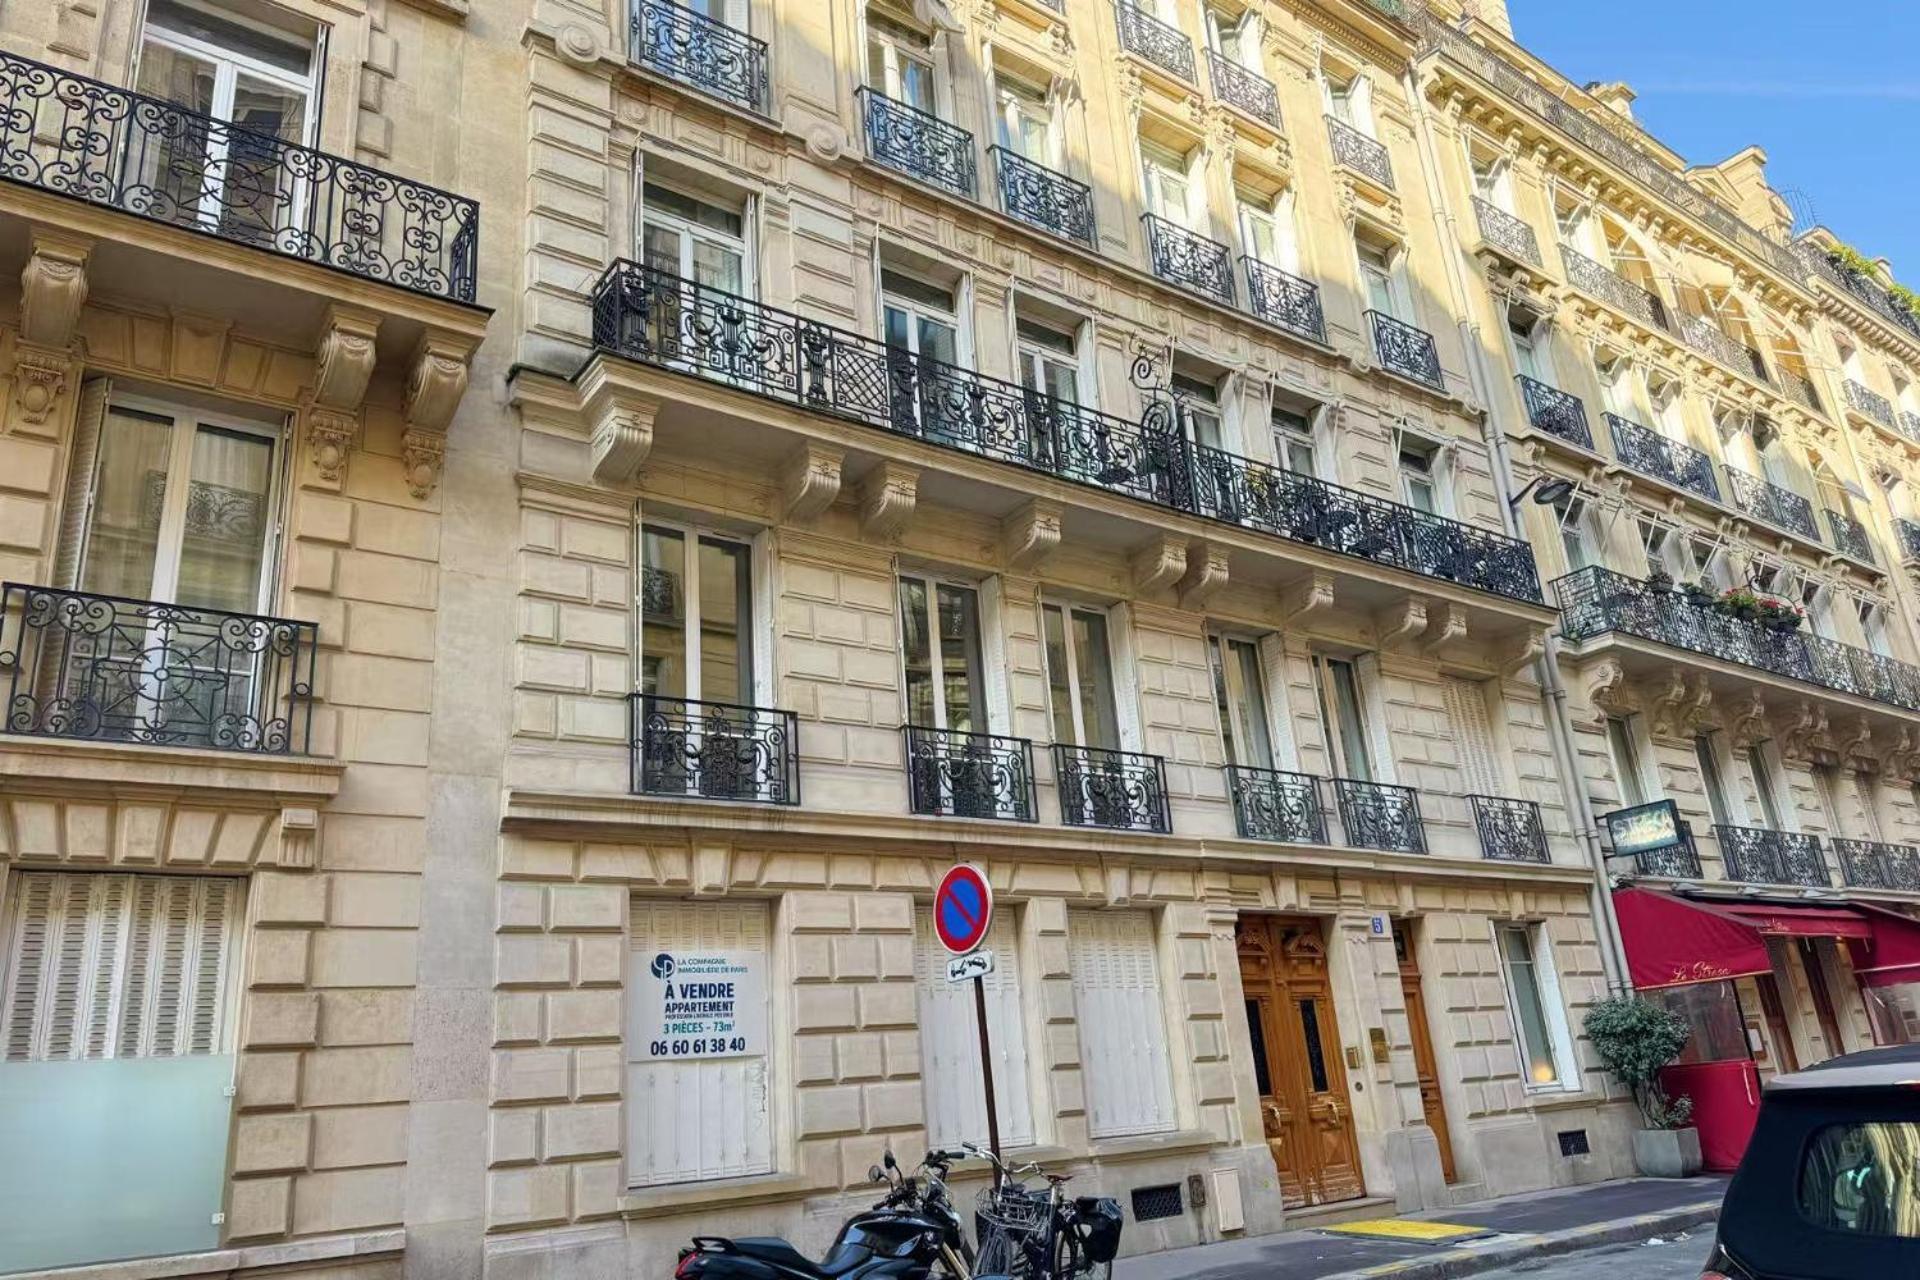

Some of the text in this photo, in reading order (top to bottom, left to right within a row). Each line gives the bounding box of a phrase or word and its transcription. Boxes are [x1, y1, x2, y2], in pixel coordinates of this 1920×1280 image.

[677, 957, 727, 966] LA COMPAGNIE
[721, 965, 729, 973] DE
[731, 965, 749, 973] PARIS
[665, 980, 735, 1000] À VENDRE
[665, 1001, 735, 1013] APPARTEMENT
[663, 1023, 669, 1035] 3
[672, 1021, 704, 1034] PIÈCES
[650, 1036, 746, 1056] 06 60 61 38 40
